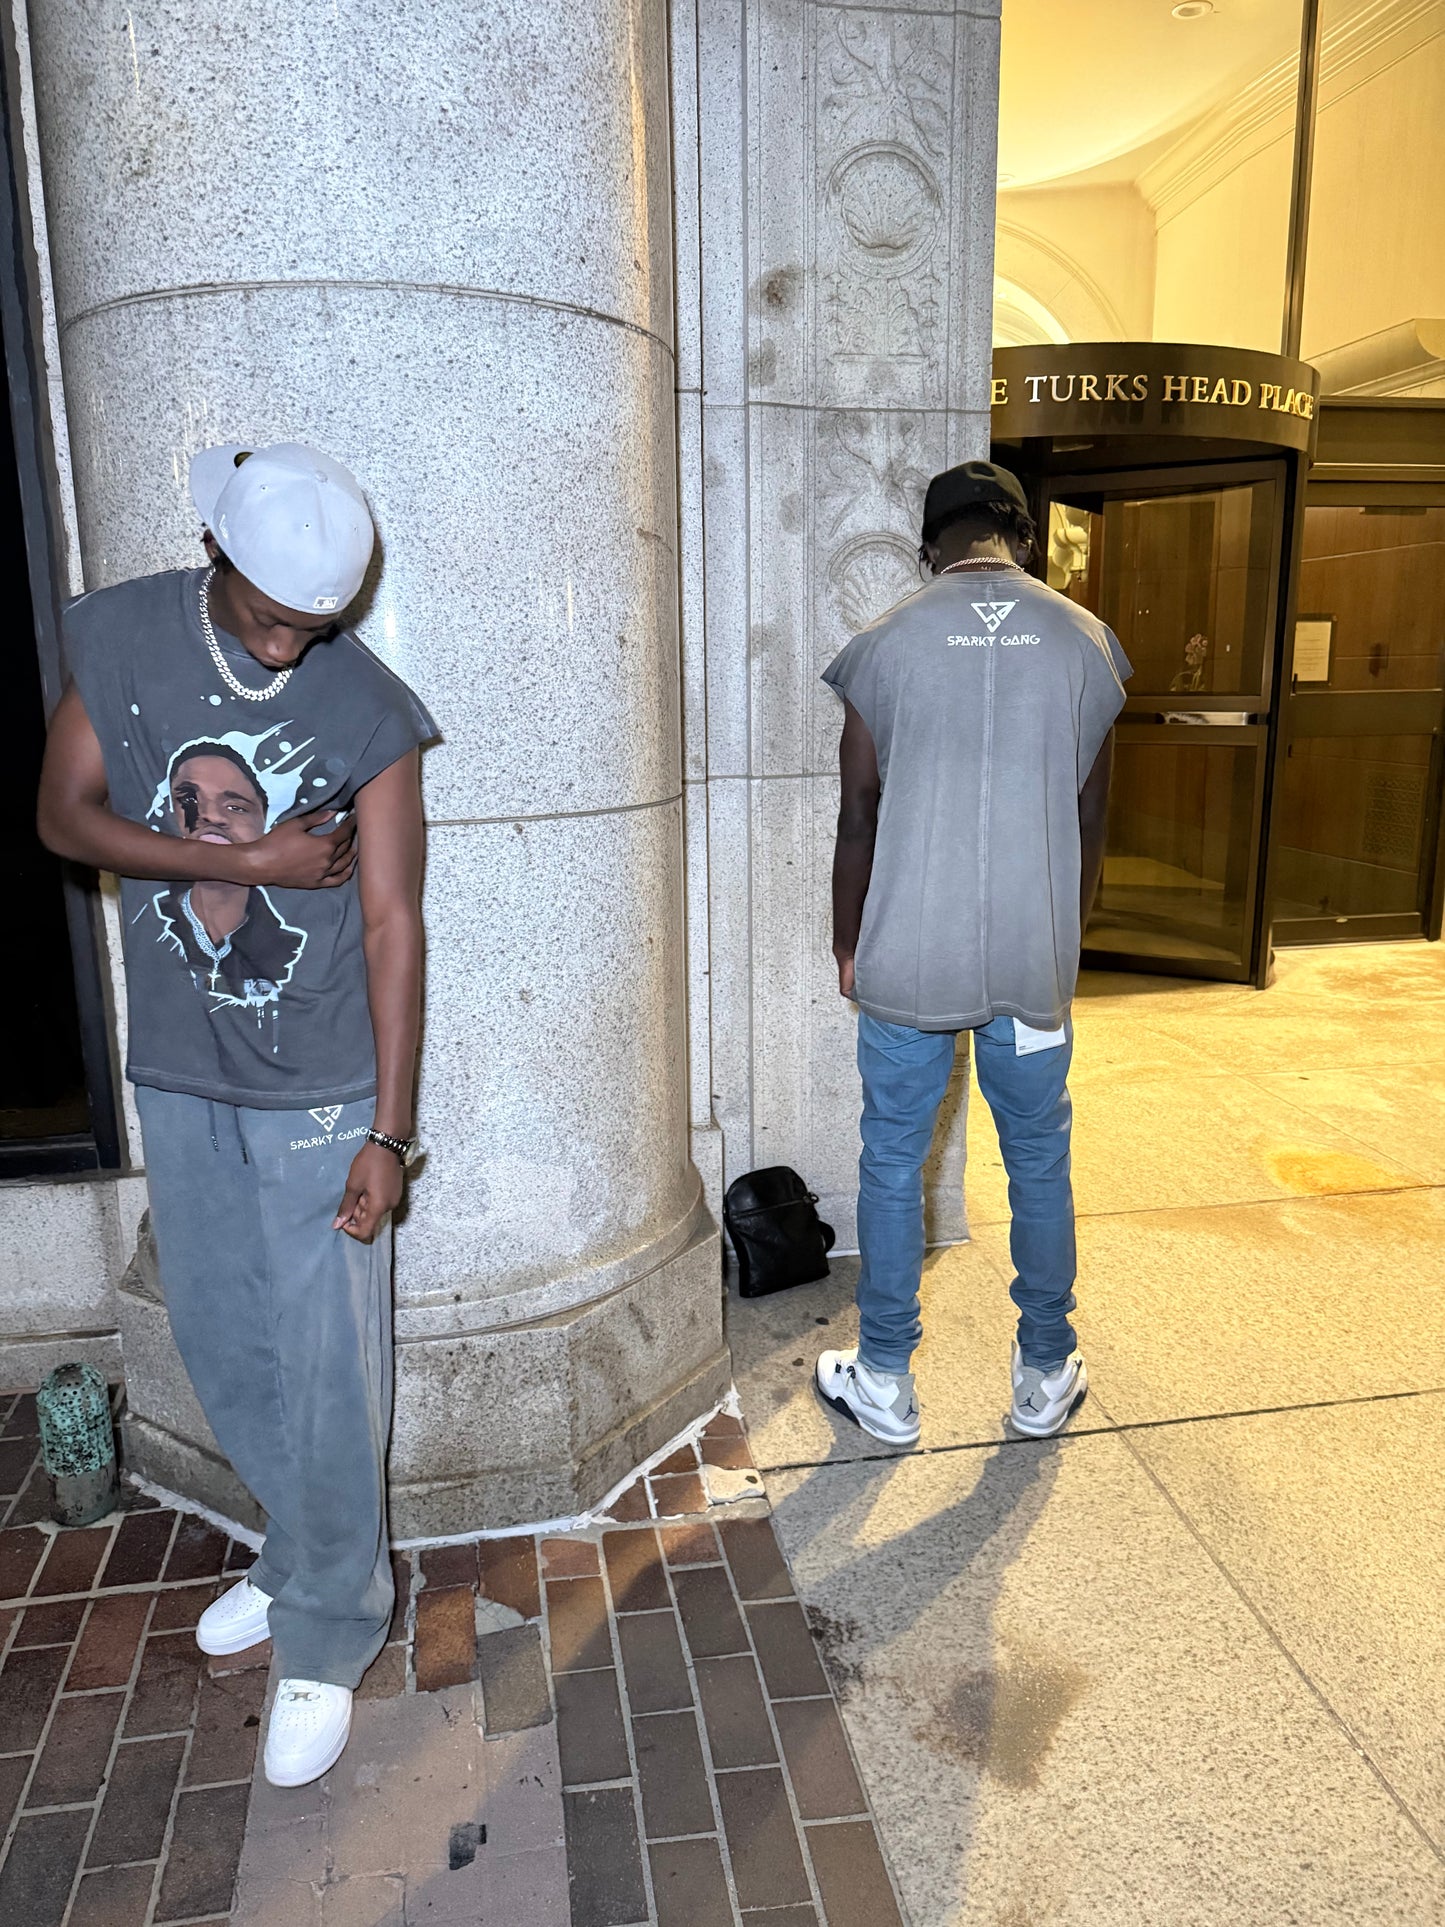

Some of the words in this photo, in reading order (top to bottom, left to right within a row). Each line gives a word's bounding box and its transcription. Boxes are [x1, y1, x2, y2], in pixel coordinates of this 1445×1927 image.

[1024, 373, 1149, 403] TURKS
[1162, 375, 1252, 407] HEAD
[1258, 382, 1315, 420] PLACE
[947, 635, 997, 647] SPARKY
[1000, 634, 1041, 646] GANG
[290, 1134, 334, 1150] SPARKY
[337, 1126, 369, 1141] GANG
